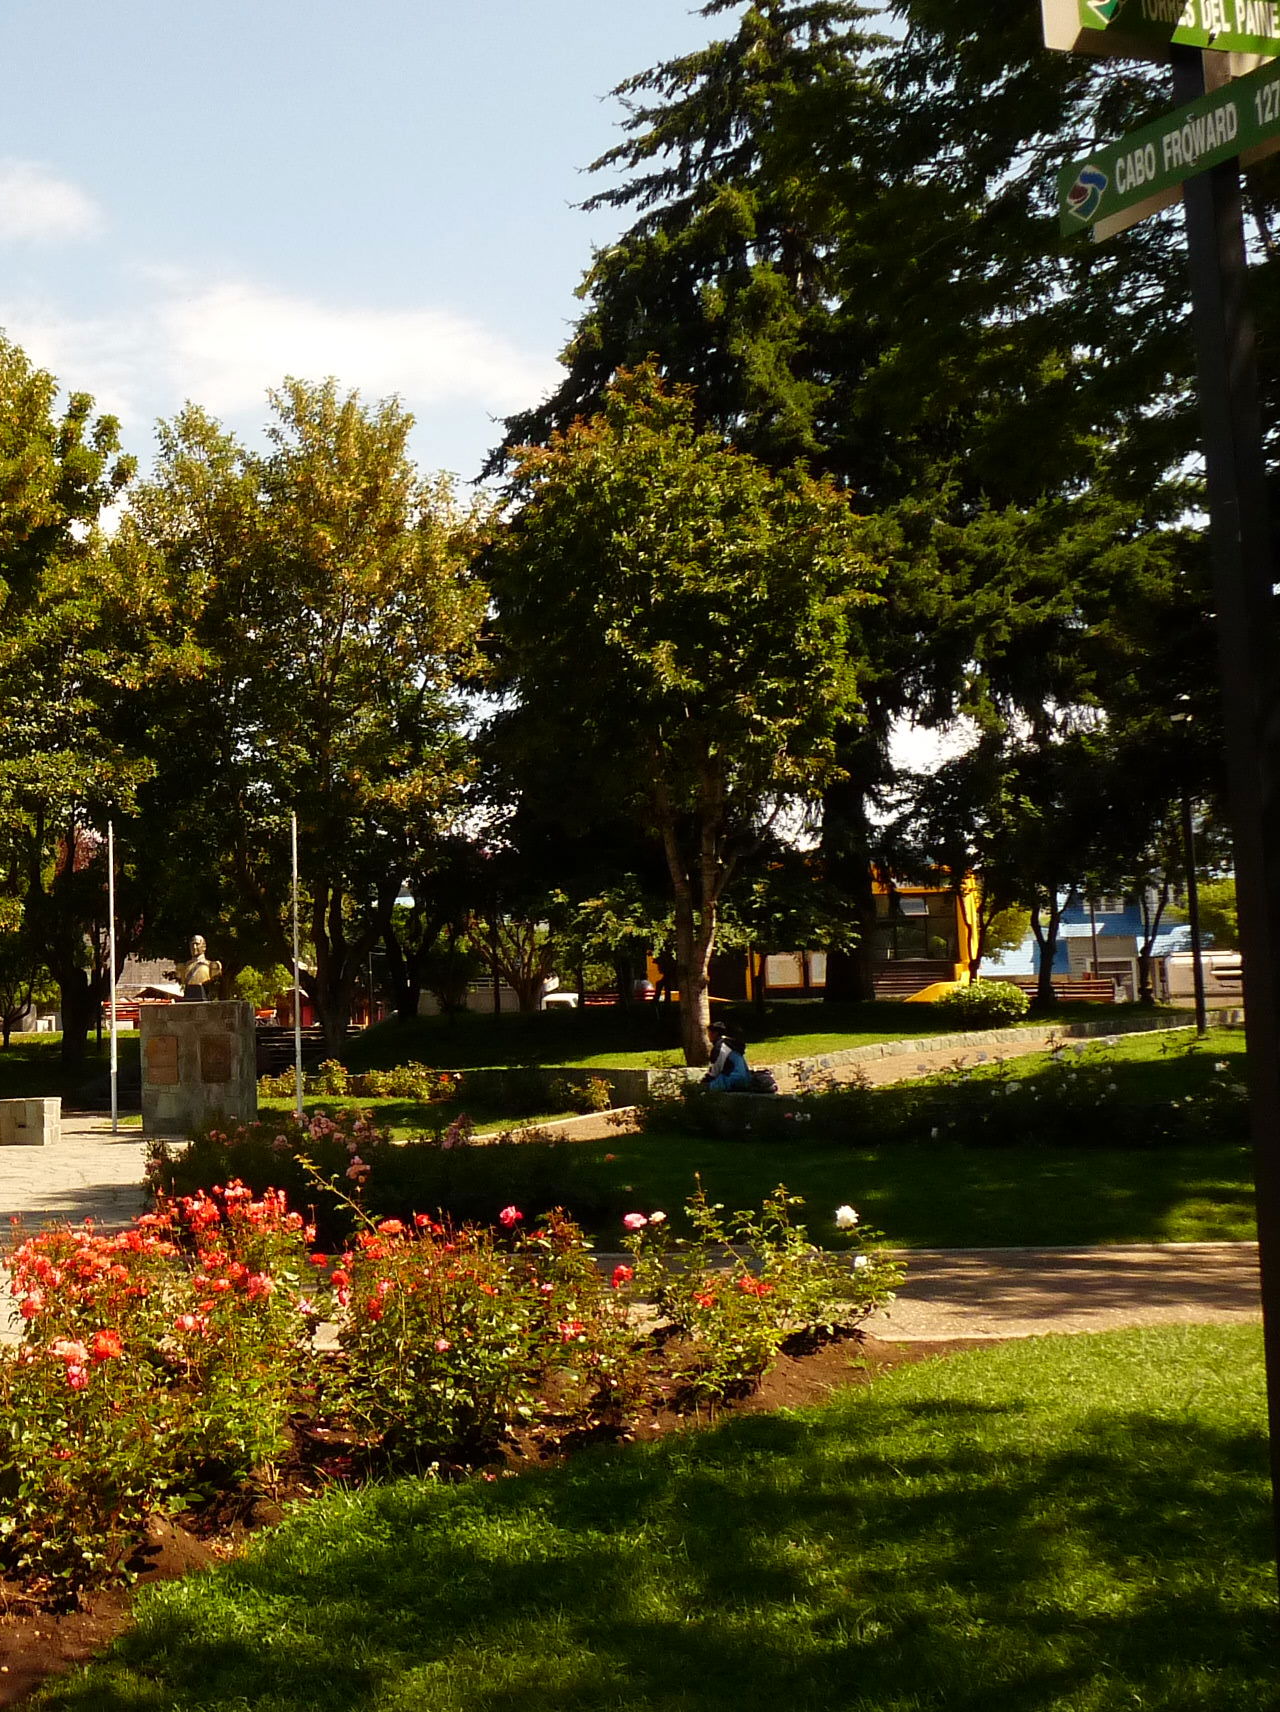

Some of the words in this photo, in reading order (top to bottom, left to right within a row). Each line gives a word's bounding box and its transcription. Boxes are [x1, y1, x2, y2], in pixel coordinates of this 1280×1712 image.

[1200, 0, 1232, 34] DEL
[1235, 0, 1280, 39] PAINE
[1115, 142, 1156, 194] CABO
[1162, 102, 1238, 172] FROWARD
